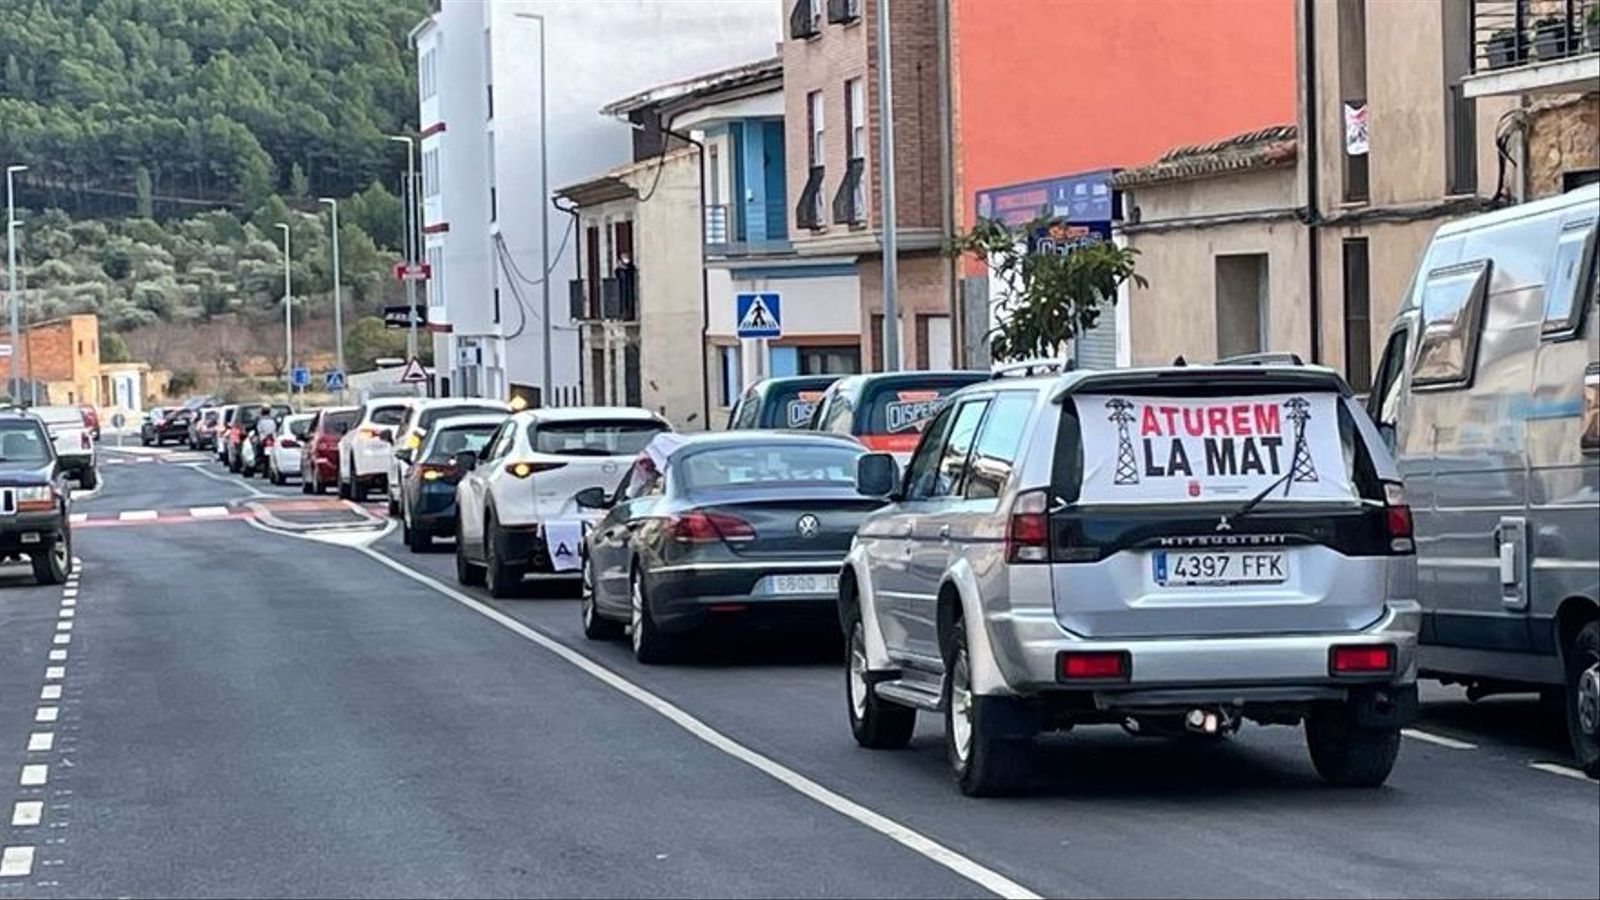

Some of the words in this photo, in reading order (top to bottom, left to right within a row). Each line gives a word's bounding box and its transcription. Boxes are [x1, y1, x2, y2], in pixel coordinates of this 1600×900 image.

[1141, 404, 1281, 436] ATUREM
[1143, 437, 1193, 477] LA
[1204, 437, 1283, 475] MAT
[1161, 535, 1285, 545] MITSUBISHI
[1174, 555, 1230, 577] 4397
[1242, 555, 1283, 576] FFK
